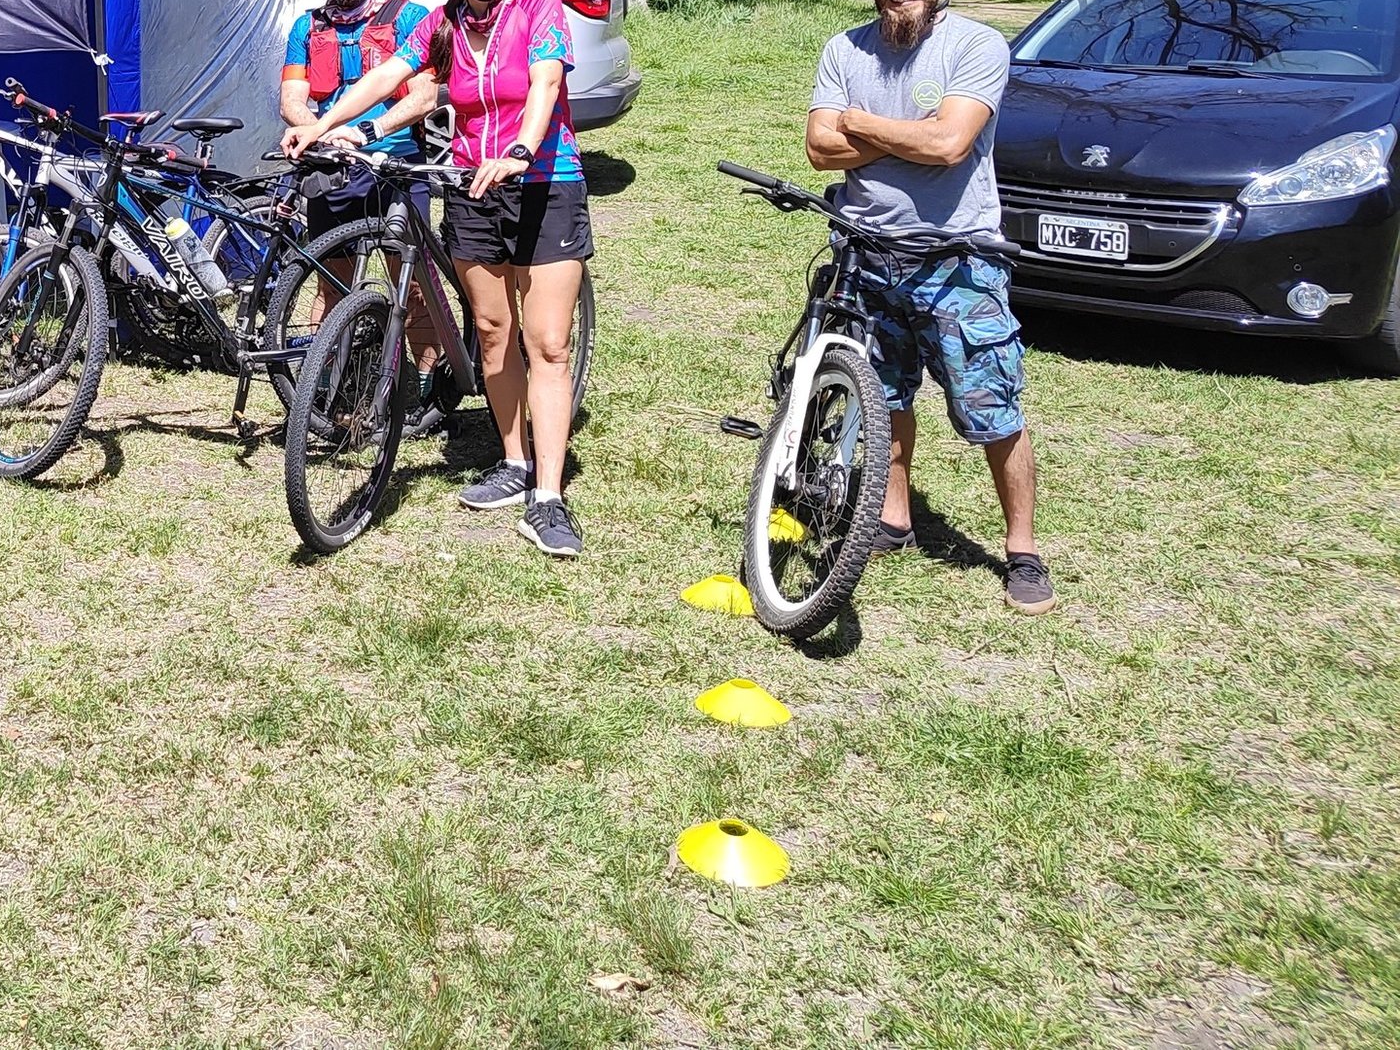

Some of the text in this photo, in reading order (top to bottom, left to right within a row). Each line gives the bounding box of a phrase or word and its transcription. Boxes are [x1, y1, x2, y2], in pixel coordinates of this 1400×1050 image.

[141, 215, 208, 300] VAIRO
[1041, 223, 1126, 253] MXC 758
